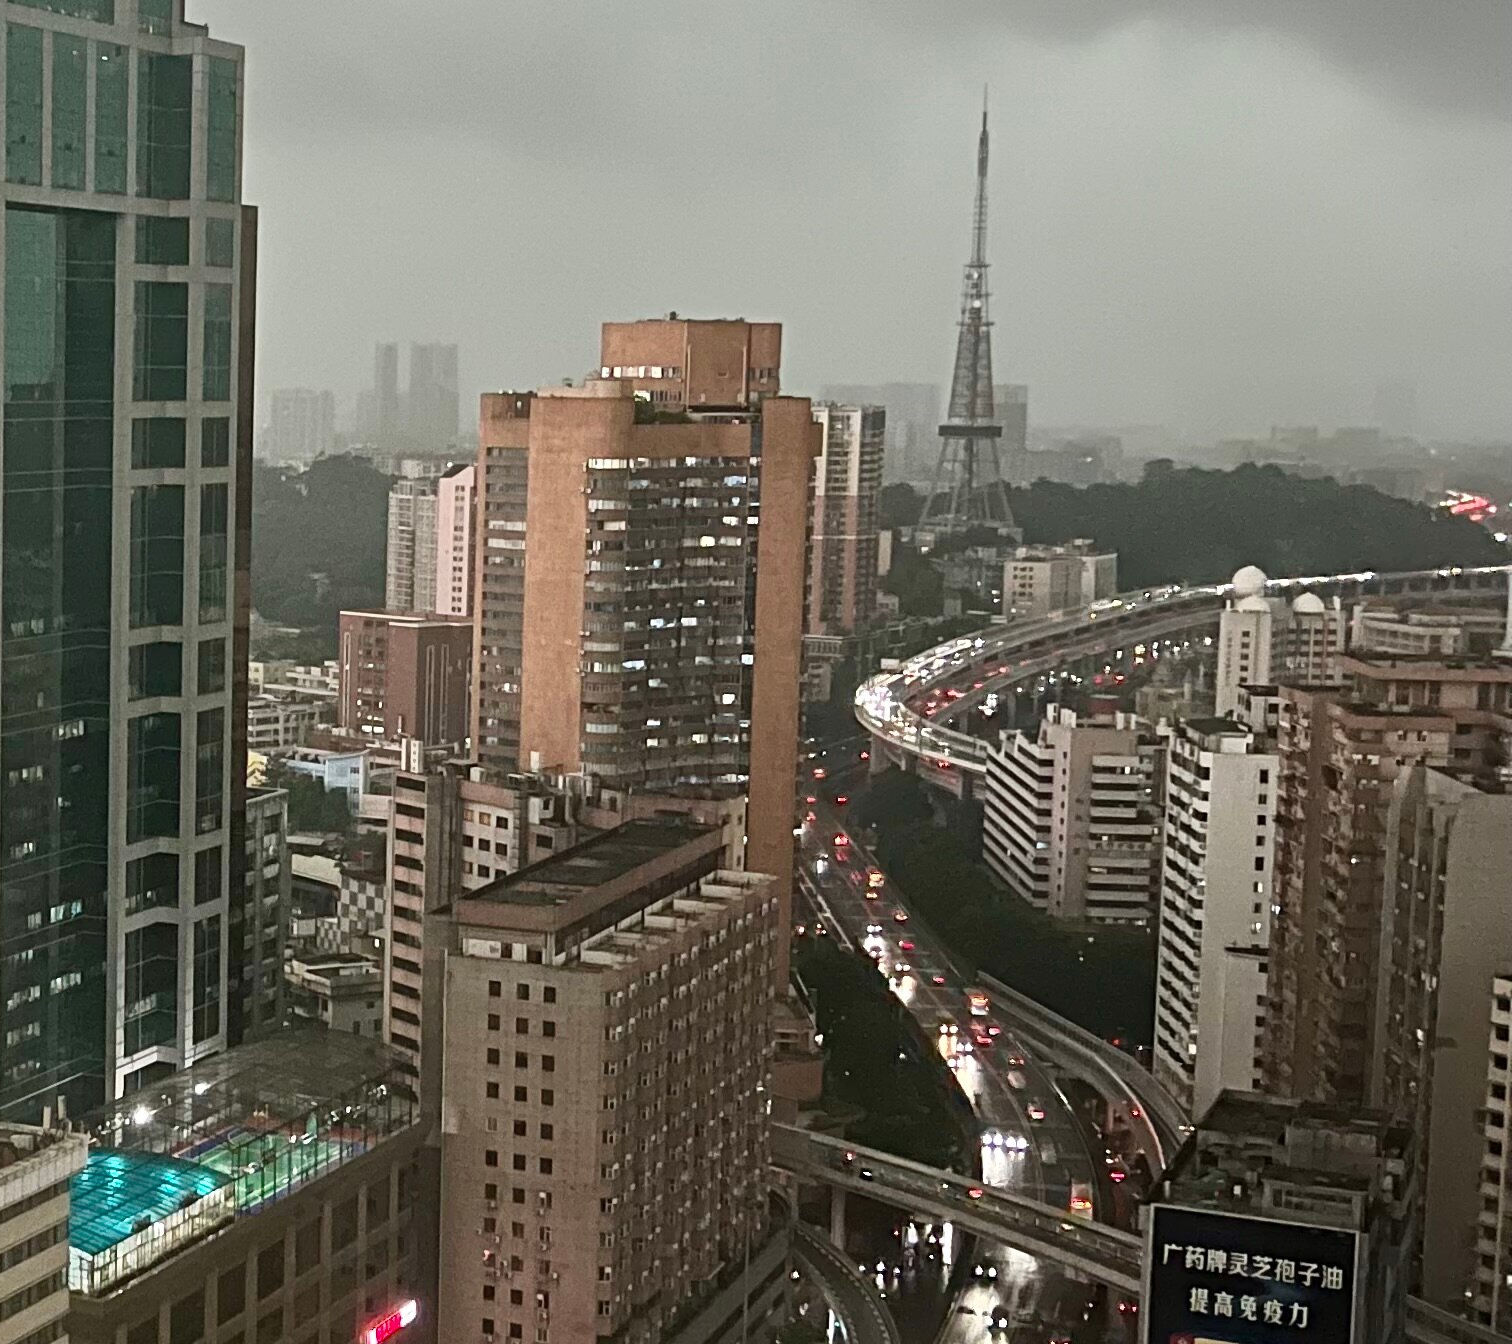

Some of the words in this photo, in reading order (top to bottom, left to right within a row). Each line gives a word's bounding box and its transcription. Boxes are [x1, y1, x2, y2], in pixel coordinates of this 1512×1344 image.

[1163, 1243, 1343, 1290] 广药牌灵芝孢子油
[1189, 1287, 1308, 1329] 提高免疫力
